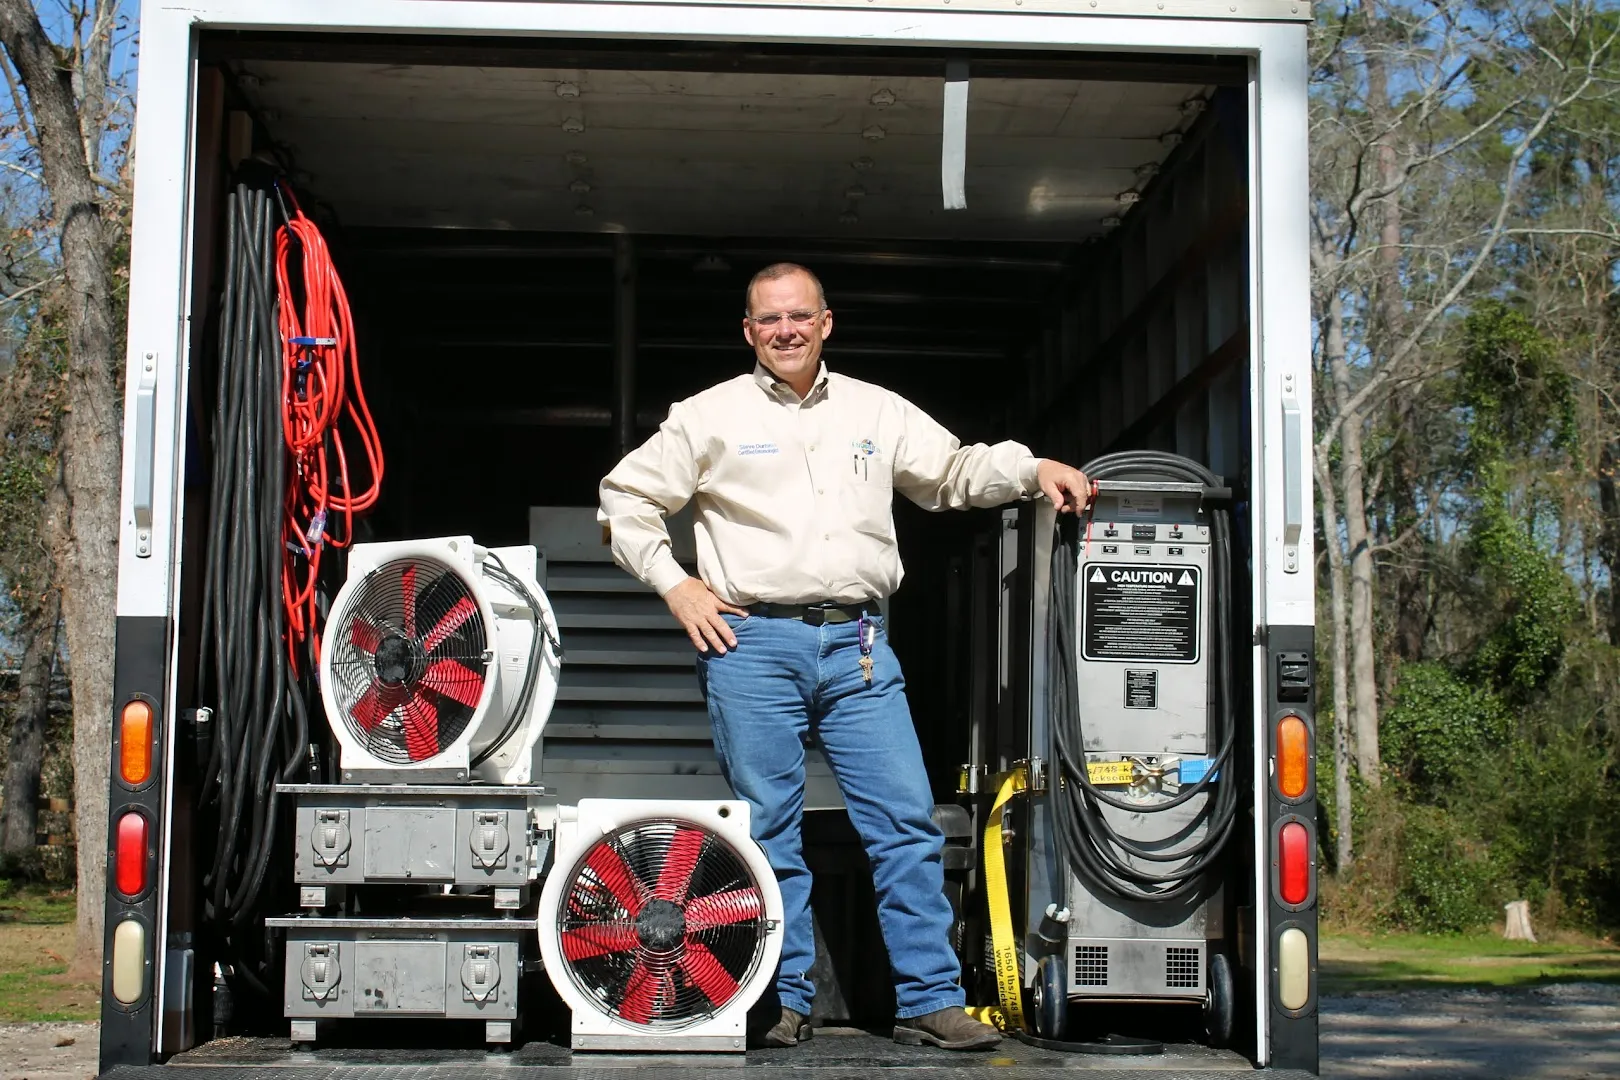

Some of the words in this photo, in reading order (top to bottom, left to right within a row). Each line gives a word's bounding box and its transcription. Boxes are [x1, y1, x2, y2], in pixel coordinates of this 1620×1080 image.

[1110, 570, 1173, 584] CAUTION
[1004, 946, 1013, 972] 1650
[1007, 975, 1019, 1011] lbs/748
